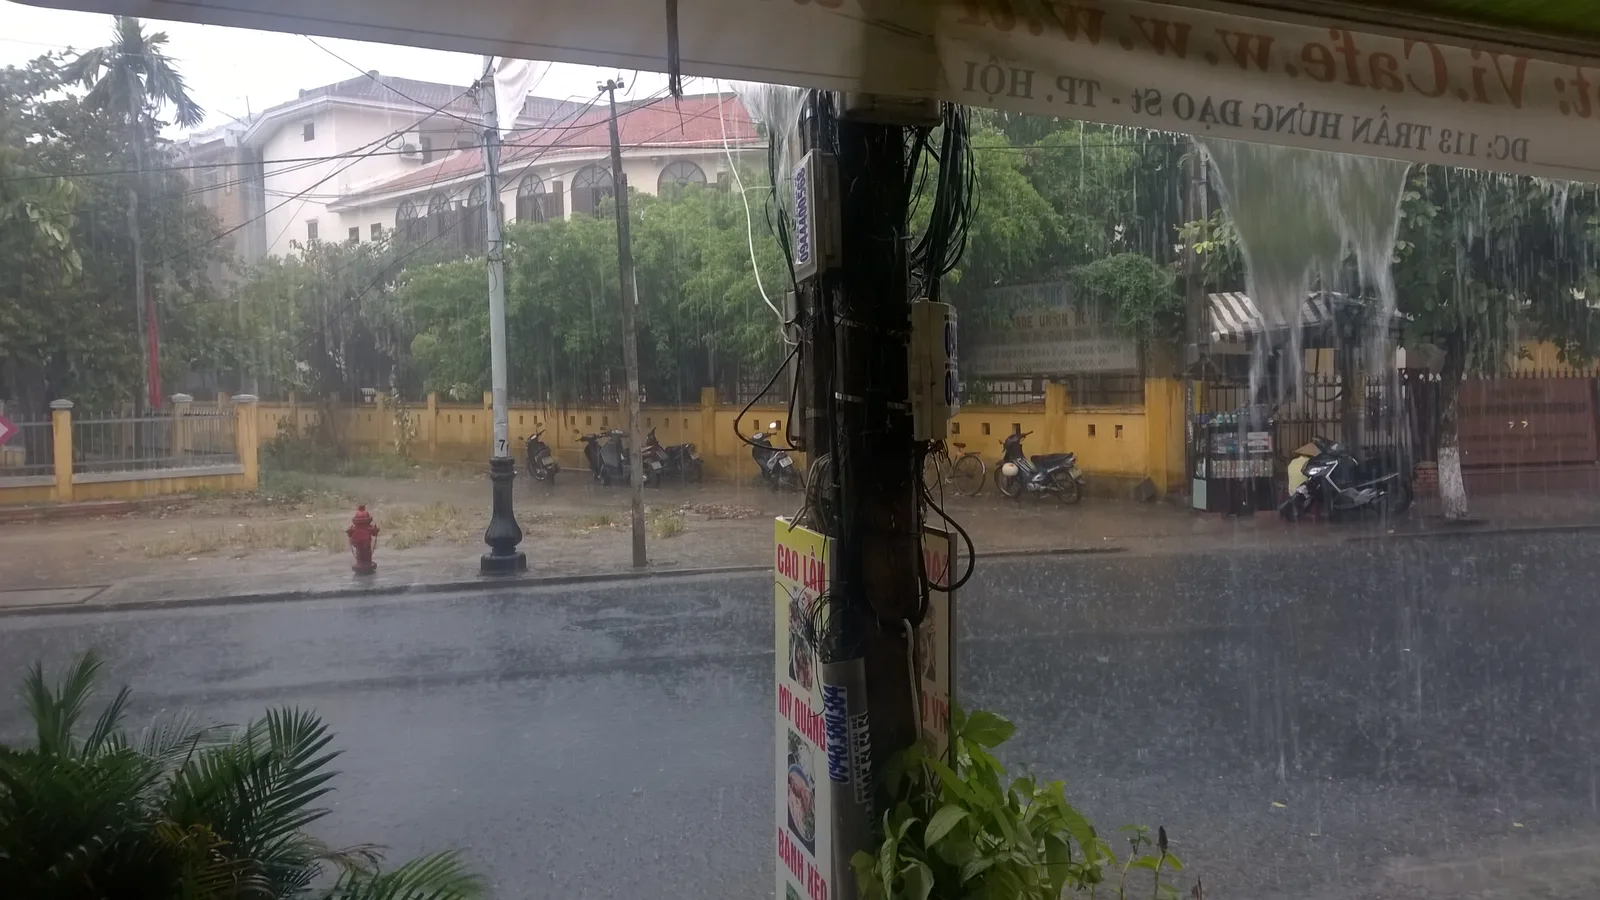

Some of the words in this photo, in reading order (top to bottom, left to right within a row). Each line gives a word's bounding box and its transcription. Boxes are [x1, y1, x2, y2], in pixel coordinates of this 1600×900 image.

[777, 543, 799, 583] CAO
[794, 697, 826, 753] QUẢNG
[778, 826, 804, 886] BÁNH
